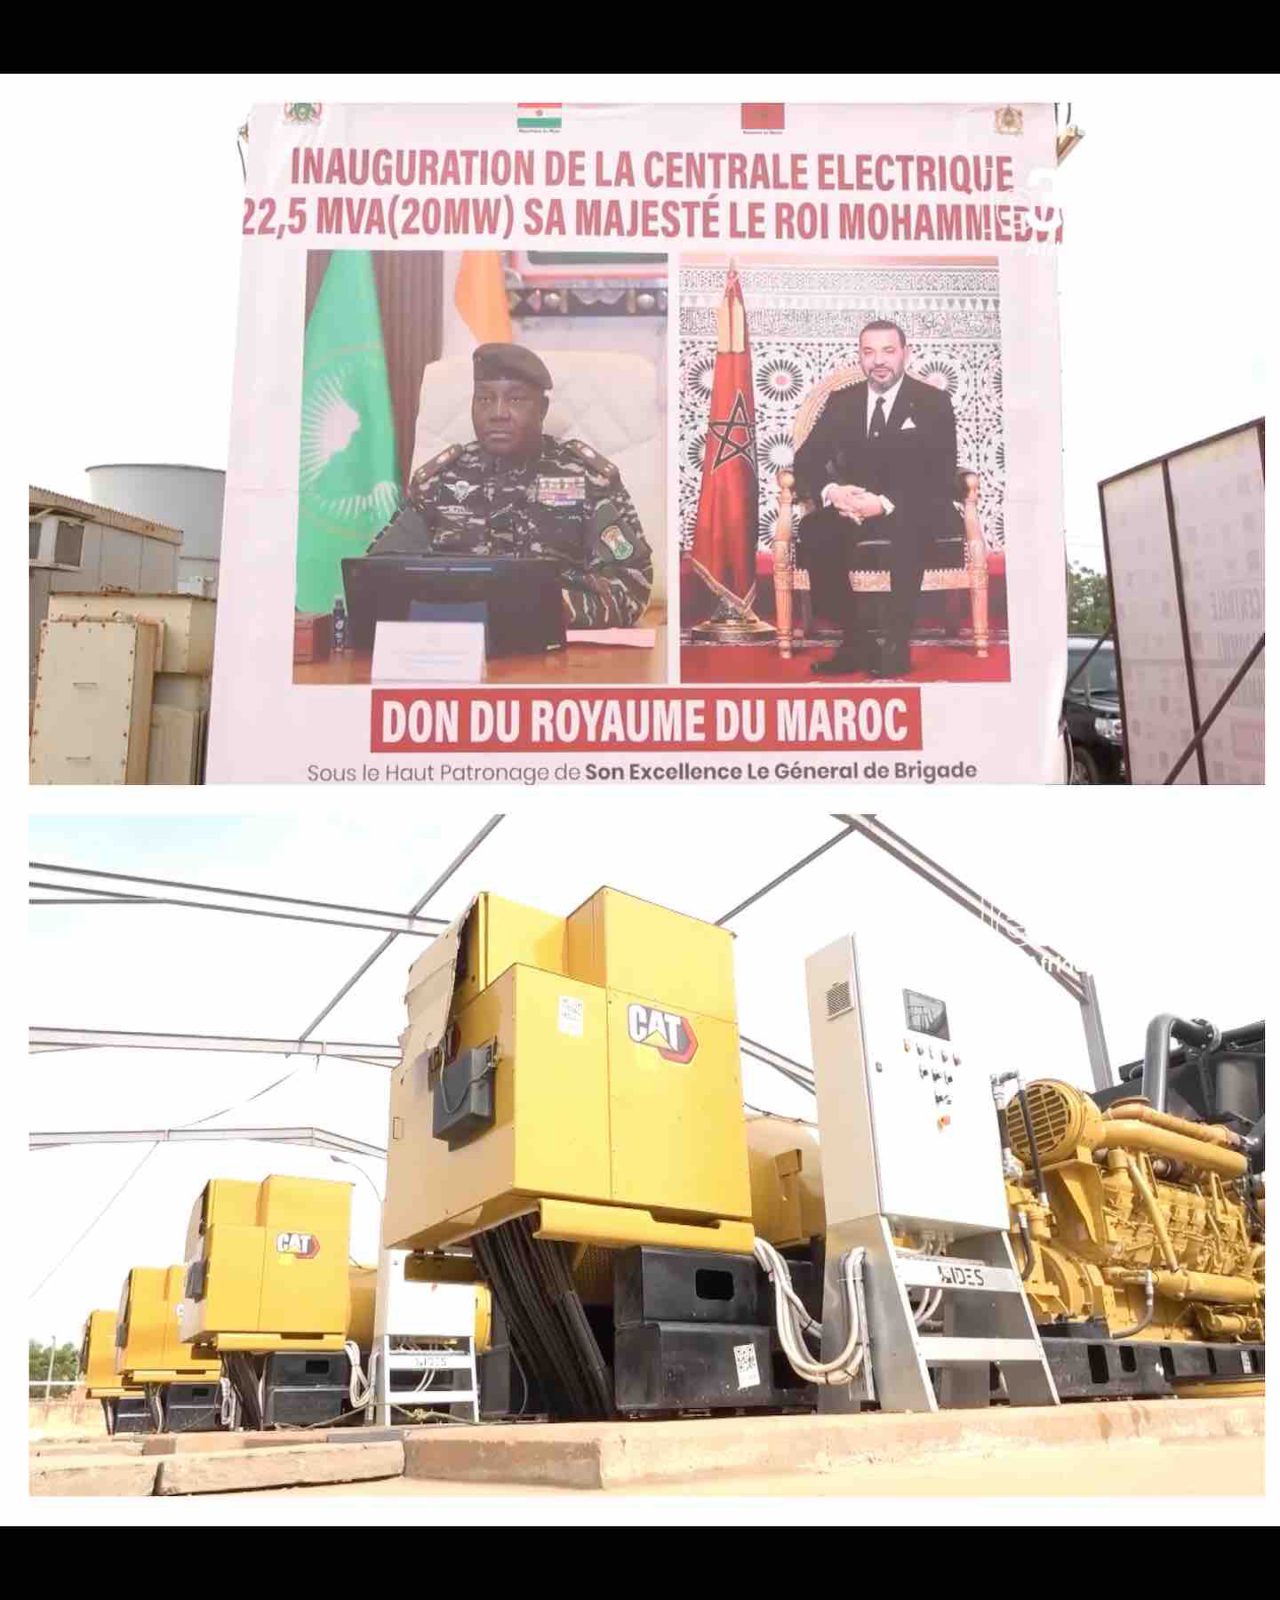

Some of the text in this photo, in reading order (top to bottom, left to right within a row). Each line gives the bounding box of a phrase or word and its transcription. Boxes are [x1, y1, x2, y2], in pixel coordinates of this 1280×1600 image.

[290, 147, 1014, 194] INAUGURATION DE LA CENTRALE ELECTRIQUE
[242, 197, 307, 240] 22,5
[316, 194, 514, 240] MVA(20MW)
[524, 198, 566, 235] SA
[575, 193, 720, 238] MAJESTÉ
[729, 201, 766, 239] LE
[776, 202, 828, 240] ROI
[382, 698, 908, 743] DON DU ROYAUME DU MAROC
[307, 764, 357, 782] Sous
[362, 763, 380, 781] le
[385, 764, 435, 781] Haut
[440, 764, 550, 785] Patronage
[554, 763, 581, 781] de
[585, 763, 626, 781] Son
[629, 762, 742, 781] Excellence
[747, 763, 770, 781] Le
[863, 761, 890, 780] de
[894, 761, 978, 784] Brigade
[628, 1003, 682, 1051] CAT
[277, 1232, 312, 1253] CAT
